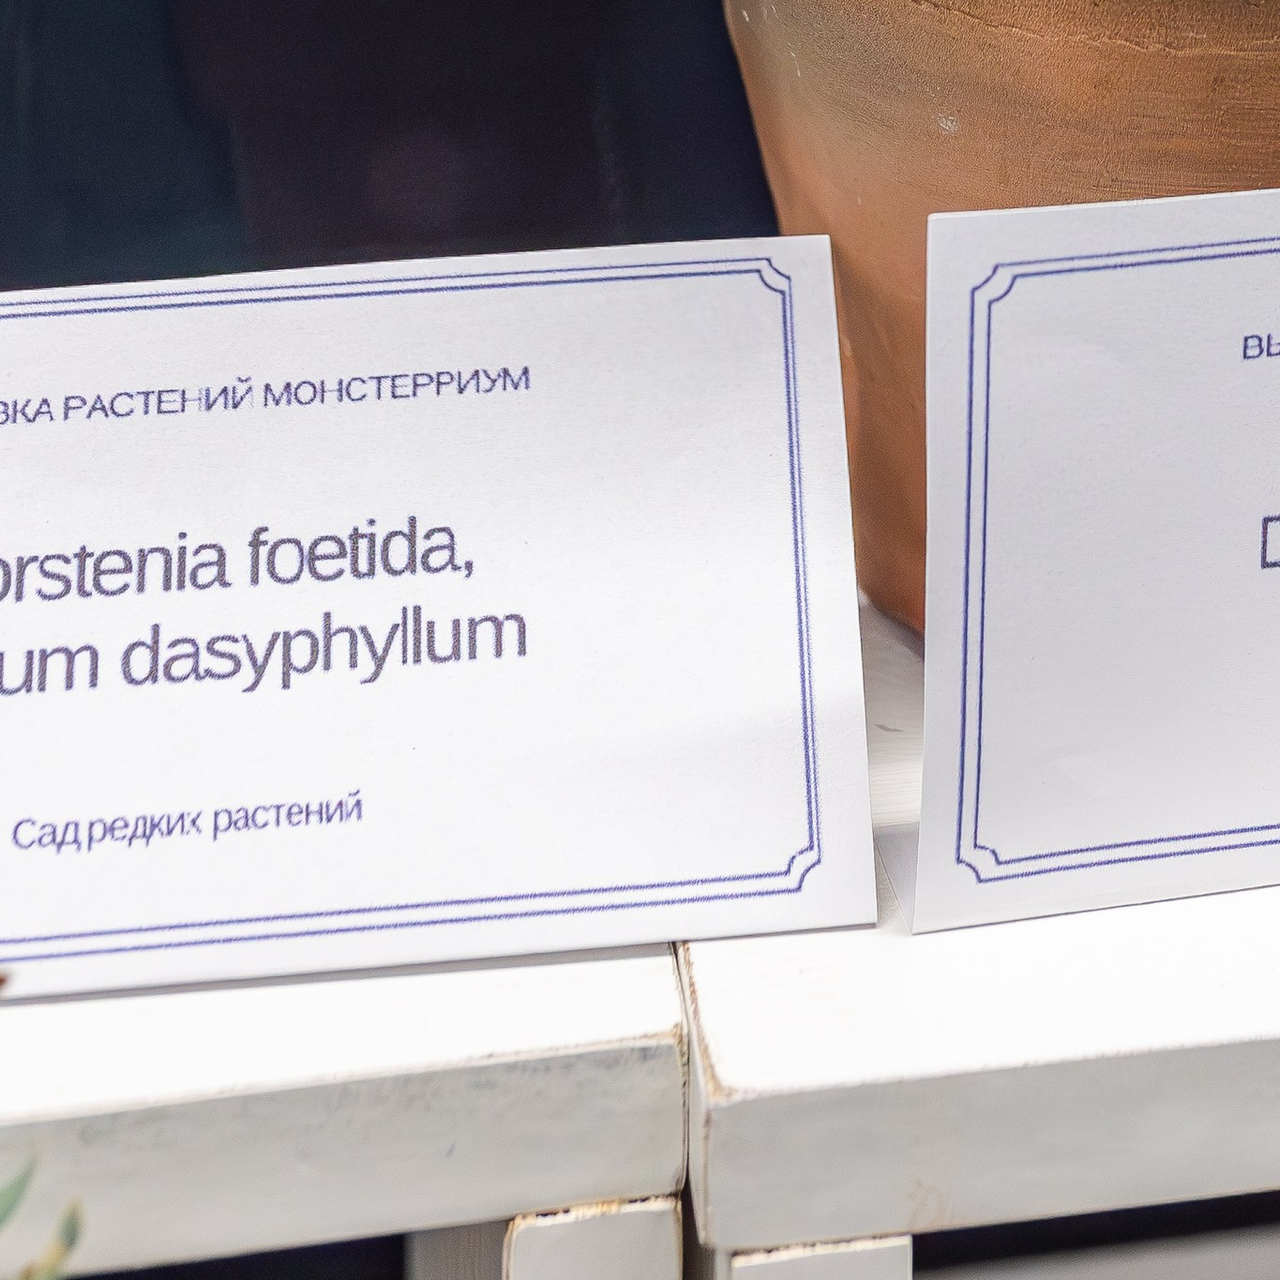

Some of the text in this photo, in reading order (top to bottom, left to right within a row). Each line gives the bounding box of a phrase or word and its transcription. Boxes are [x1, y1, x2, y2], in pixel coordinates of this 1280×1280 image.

[62, 375, 254, 422] РАСТЕНИЙ
[262, 365, 532, 409] МОНСТЕРРИУМ
[247, 514, 474, 586] foetida,
[120, 603, 528, 694] dasyphyllum
[12, 788, 364, 855] Сад редких растений
